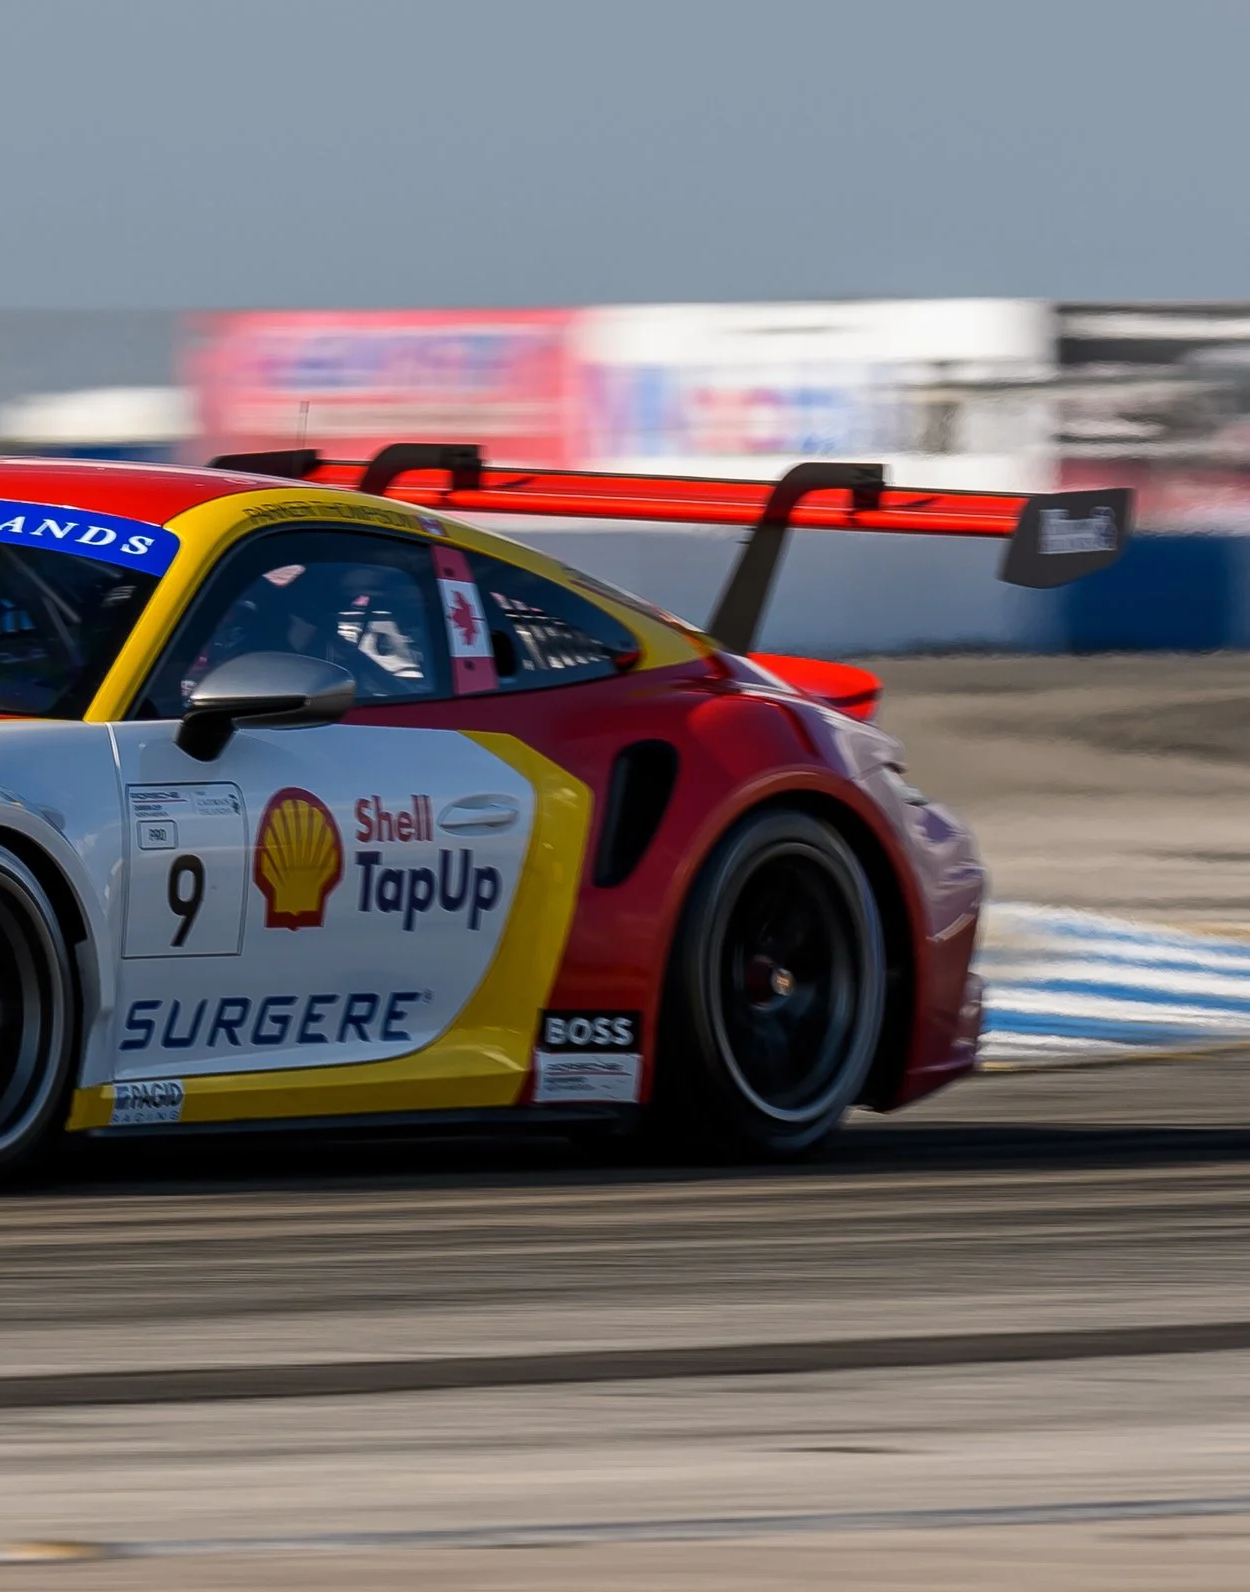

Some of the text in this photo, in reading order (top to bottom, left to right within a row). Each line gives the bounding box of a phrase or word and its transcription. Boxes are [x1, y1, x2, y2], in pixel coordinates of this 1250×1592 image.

[354, 794, 434, 843] Shell
[167, 854, 206, 948] 9
[354, 848, 502, 931] TapUp
[545, 1016, 635, 1046] BOSS
